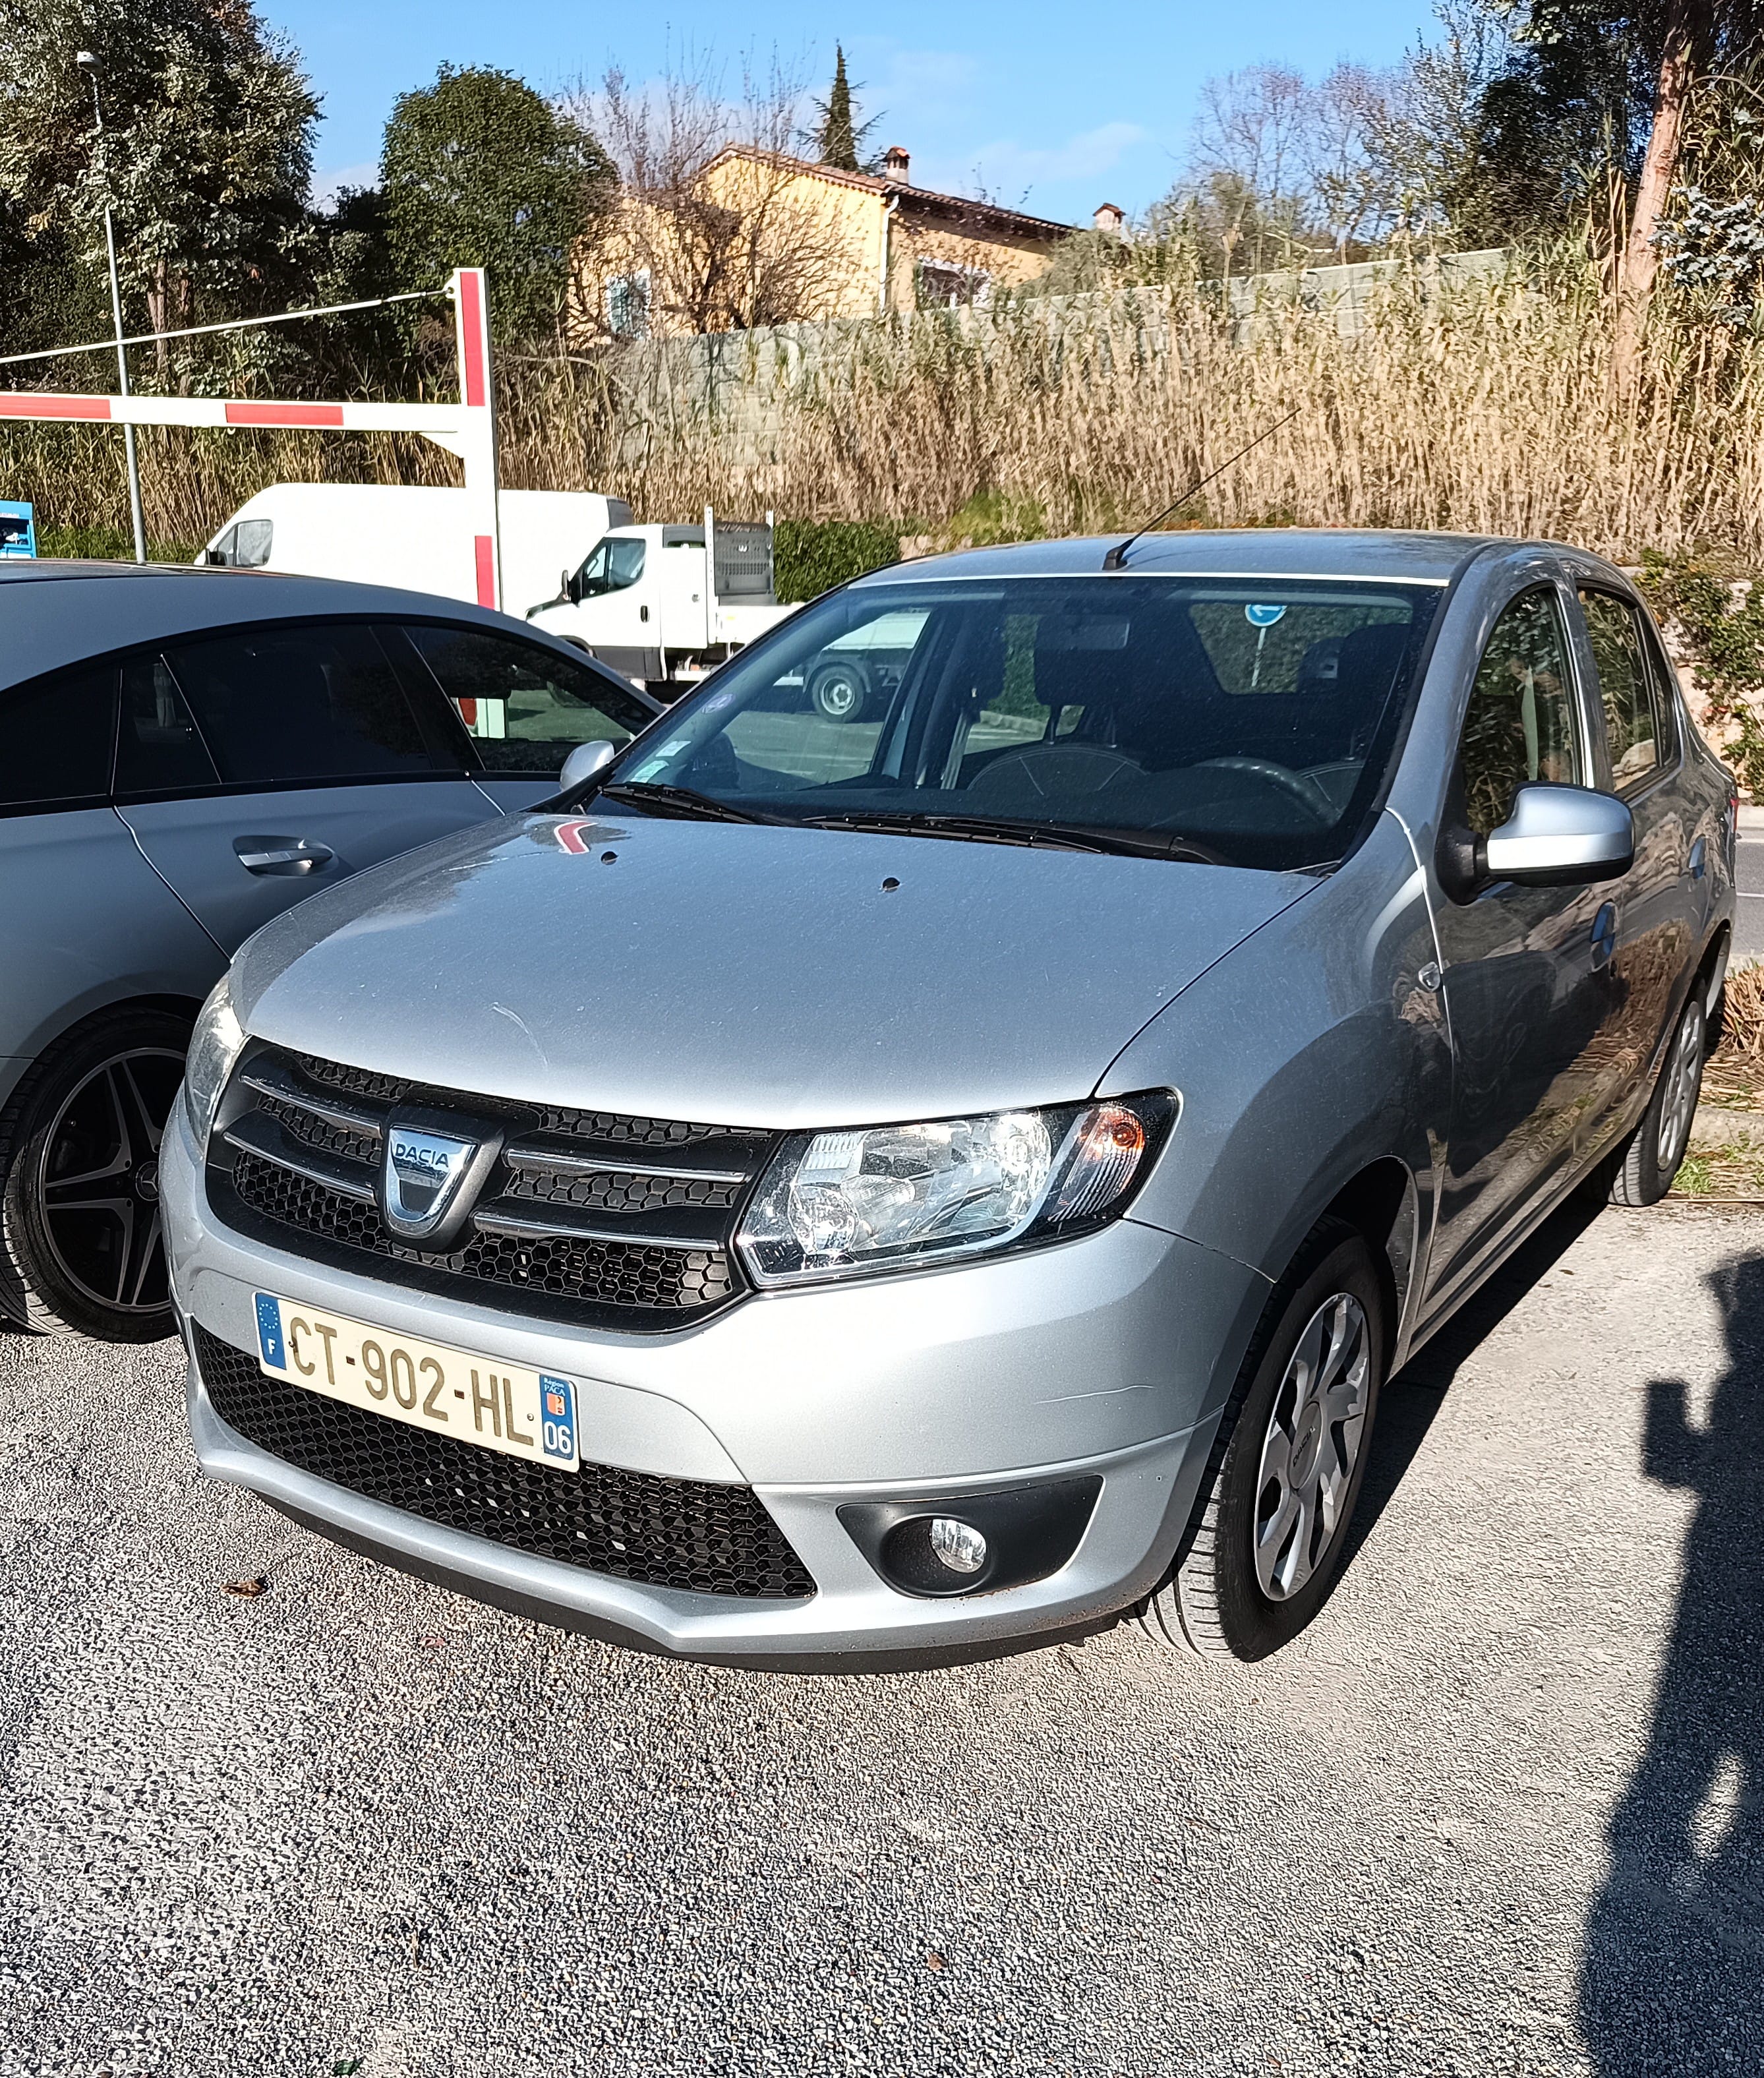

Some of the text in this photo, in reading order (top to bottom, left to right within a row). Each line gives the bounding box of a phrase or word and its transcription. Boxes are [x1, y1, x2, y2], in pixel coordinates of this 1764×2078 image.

[395, 1143, 450, 1168] DACIA
[268, 1338, 276, 1355] F
[290, 1317, 535, 1446] CT-902-HL
[544, 1383, 566, 1397] PACA
[544, 1421, 572, 1454] 06
